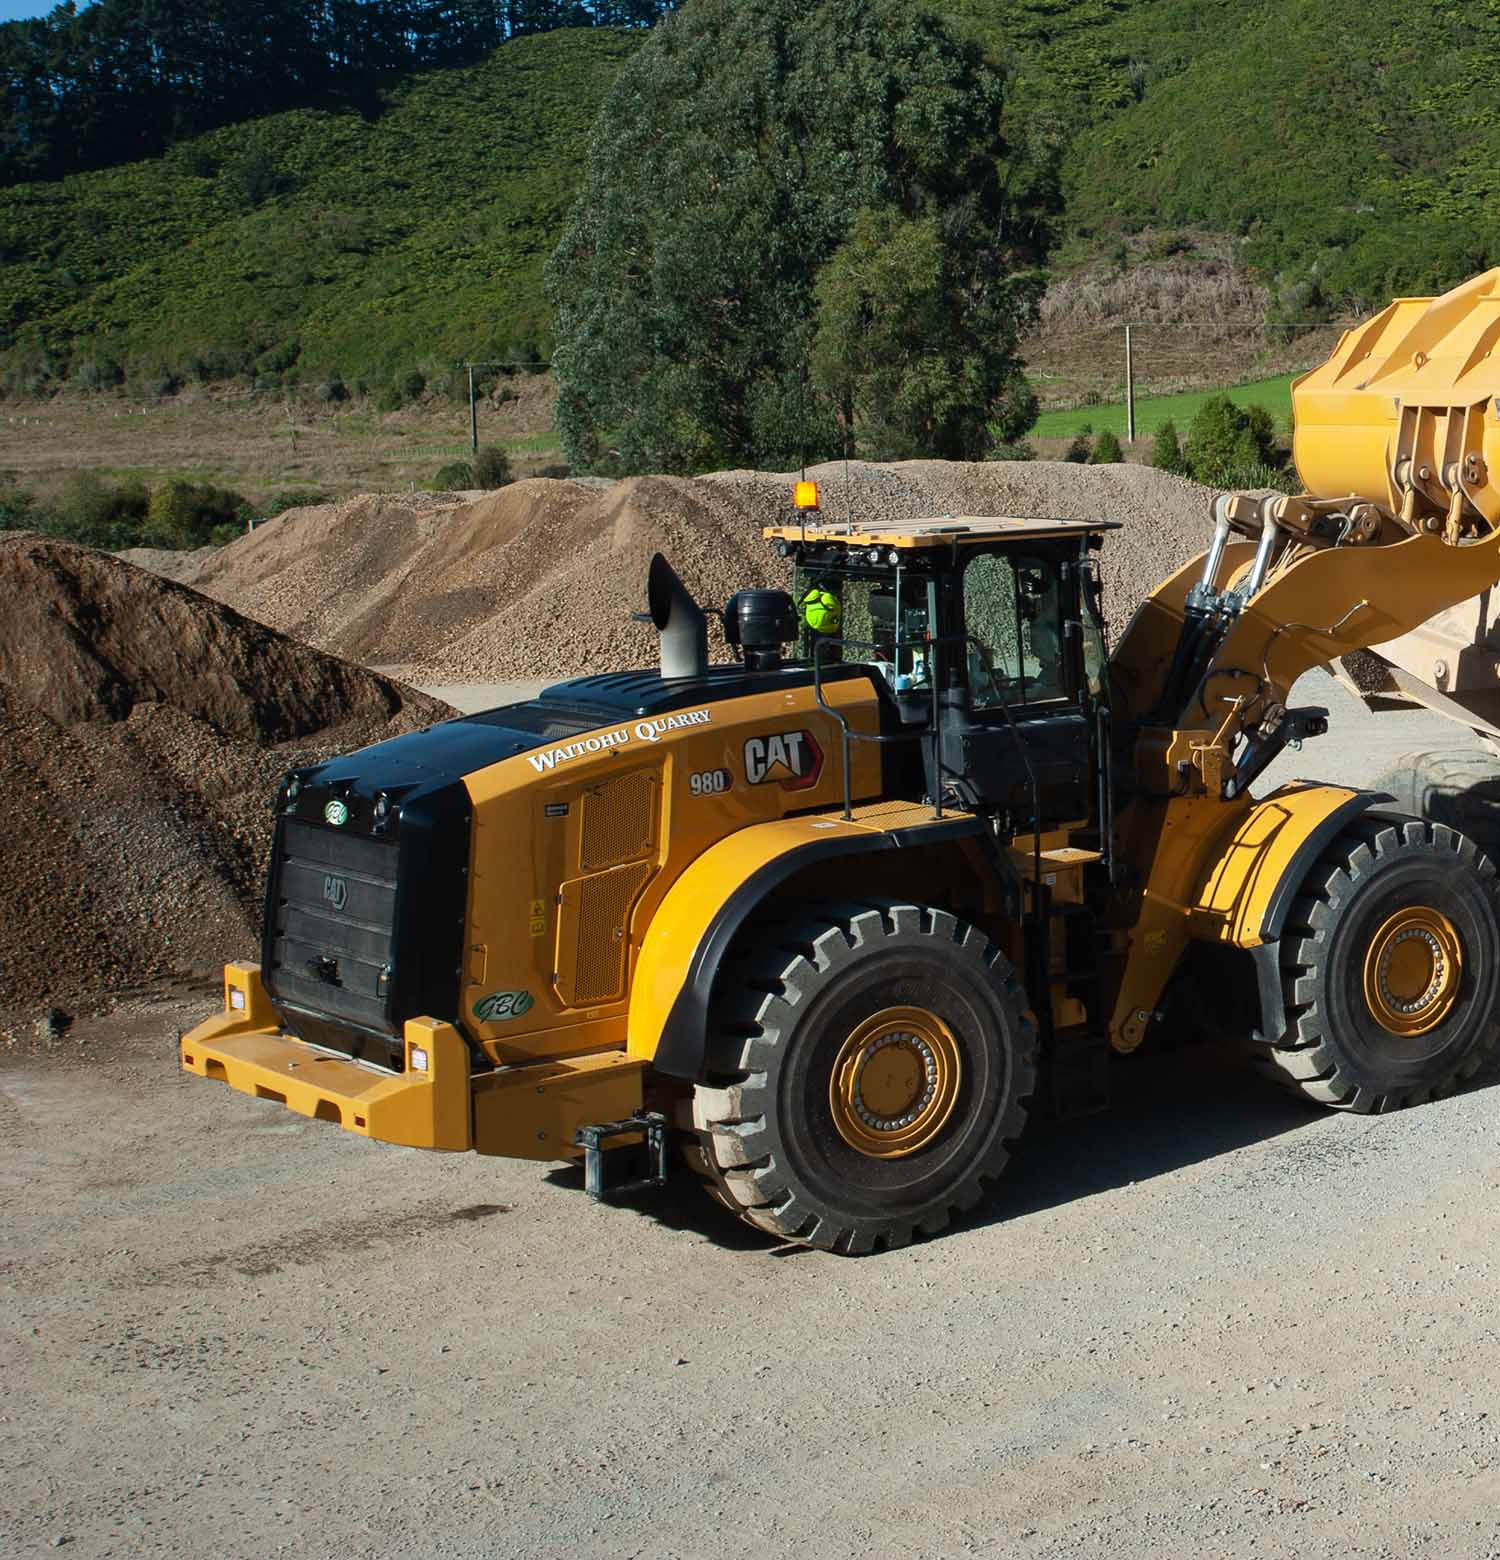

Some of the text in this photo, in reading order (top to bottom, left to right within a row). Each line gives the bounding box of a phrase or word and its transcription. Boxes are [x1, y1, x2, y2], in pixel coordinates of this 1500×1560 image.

[527, 709, 712, 773] WAITOHU QUARRY
[745, 731, 803, 784] CAT
[690, 769, 724, 795] 980
